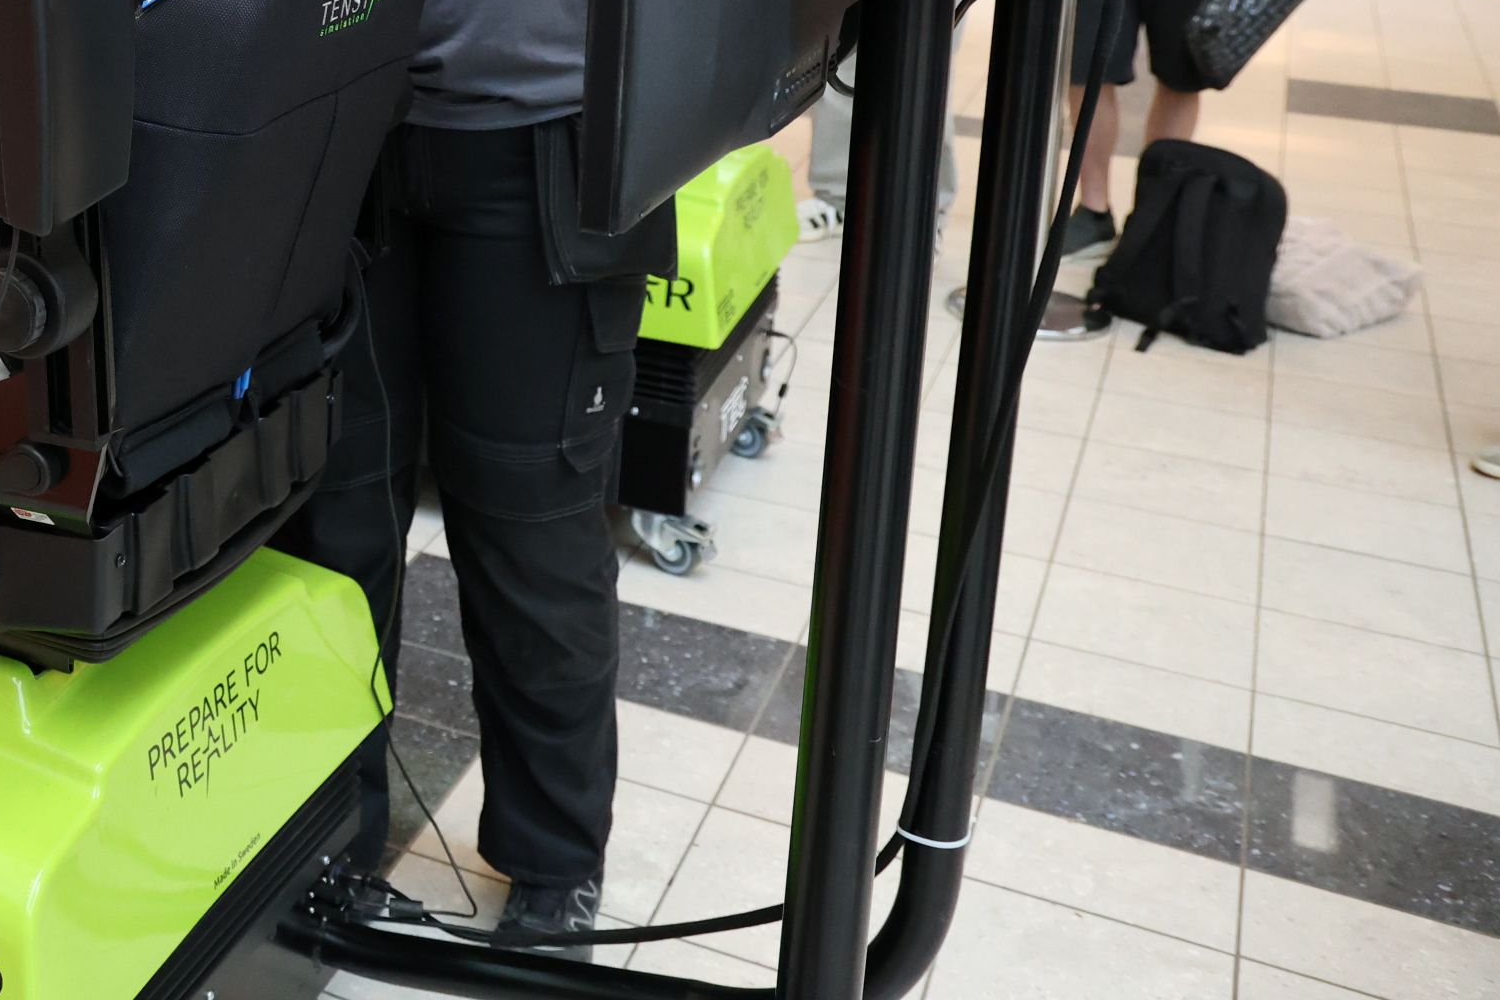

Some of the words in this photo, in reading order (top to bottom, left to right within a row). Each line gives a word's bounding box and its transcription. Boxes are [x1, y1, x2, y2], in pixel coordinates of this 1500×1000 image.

[148, 669, 239, 781] PREPARE
[244, 631, 282, 687] FOR
[177, 688, 260, 799] REALITY
